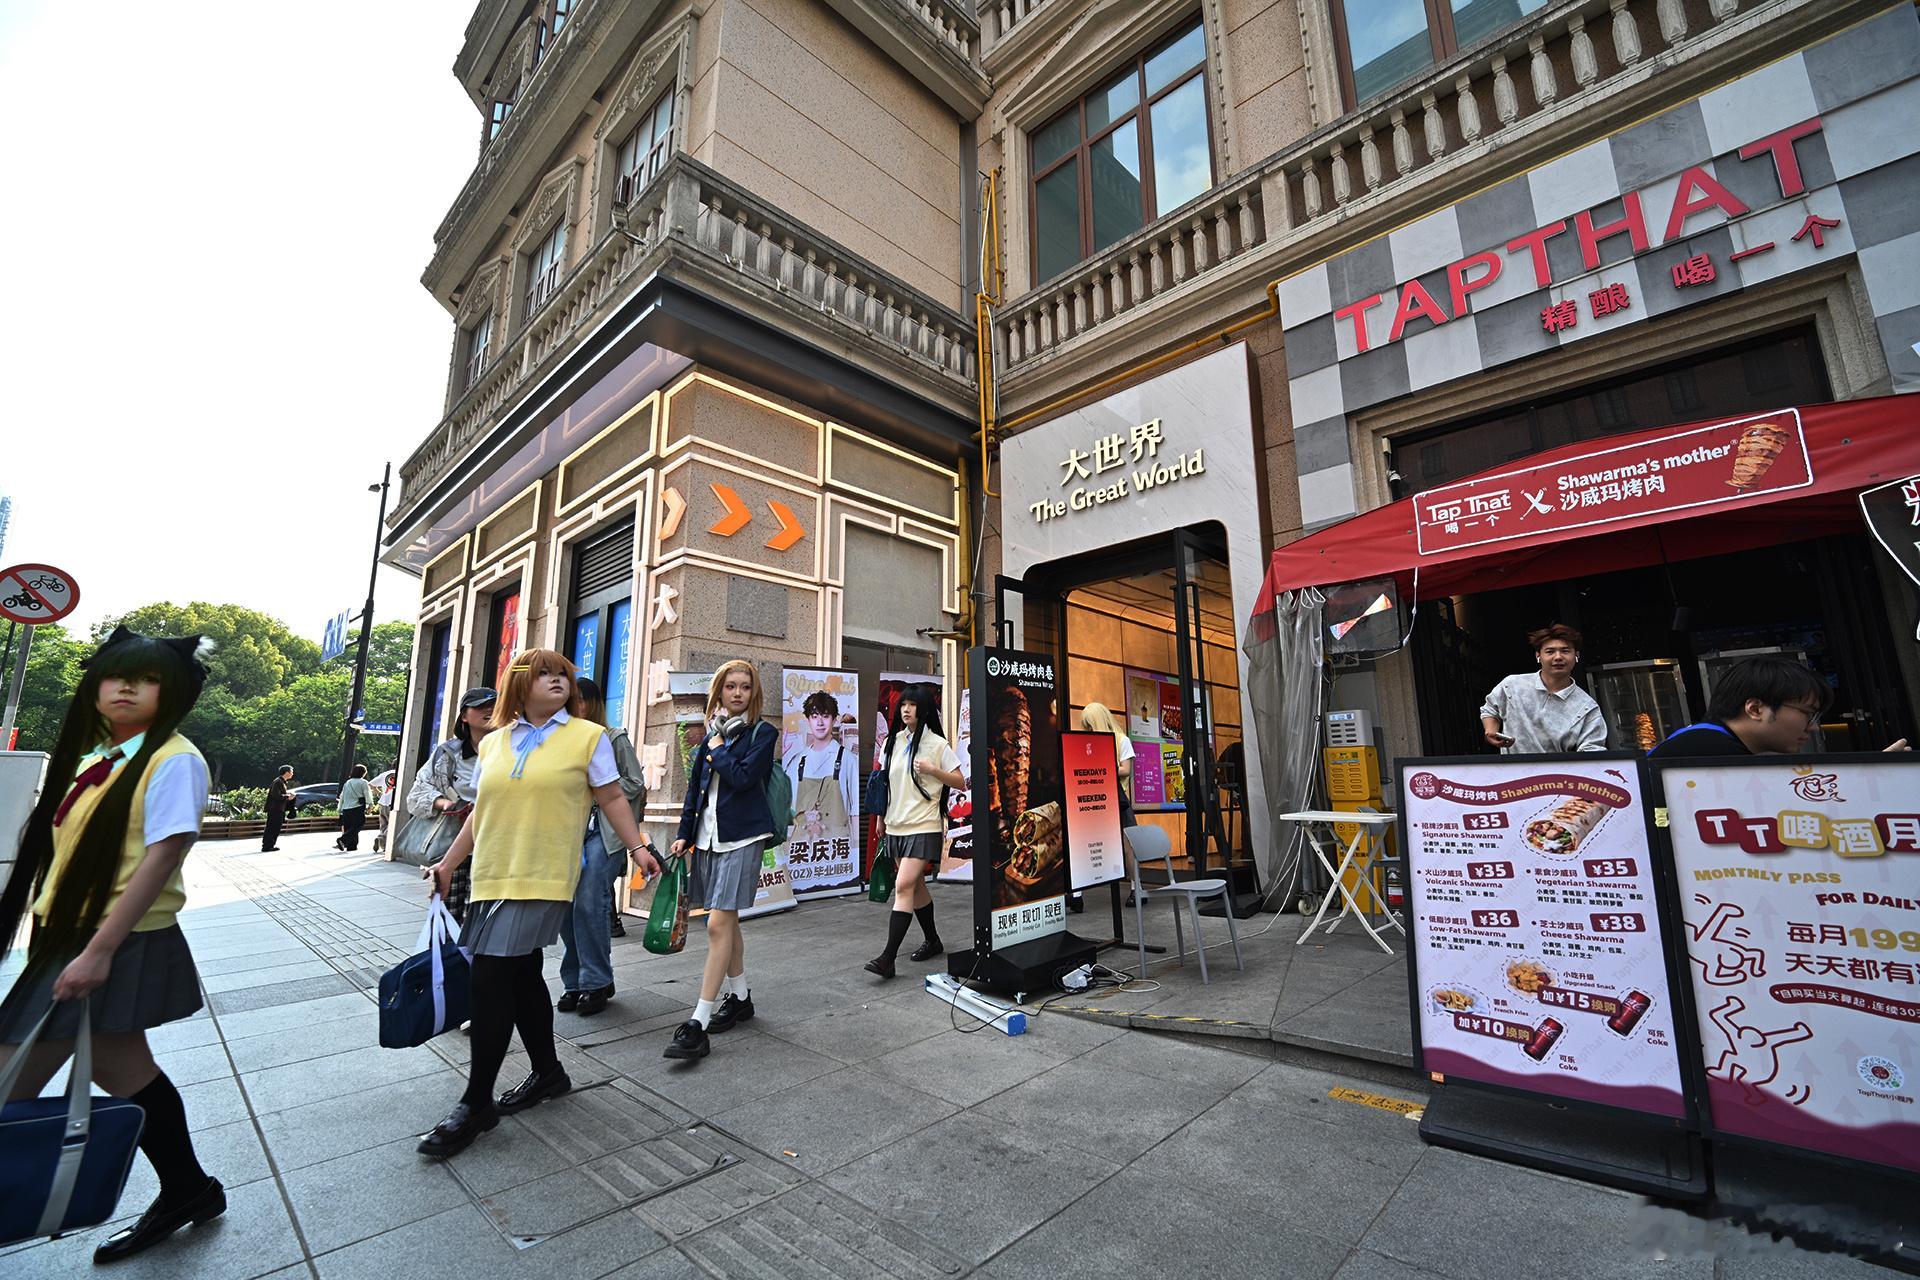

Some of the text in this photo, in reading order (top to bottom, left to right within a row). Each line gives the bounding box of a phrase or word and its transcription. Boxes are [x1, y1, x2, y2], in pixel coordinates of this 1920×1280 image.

[1540, 214, 1840, 335] 精酿 喝一个
[1059, 417, 1165, 487] 大世界
[1557, 458, 1661, 490] Shawarma's
[1029, 449, 1205, 523] The Great World
[1560, 474, 1666, 511] 沙威玛烤肉
[1426, 489, 1511, 522] Tap That
[1445, 514, 1500, 534] 喝一个
[1000, 660, 1054, 680] 沙威玛烤肉卷
[1074, 768, 1107, 776] WEEKDAYS
[1077, 794, 1107, 804] WEEKEND
[1442, 784, 1498, 800] 沙威玛烤肉
[1578, 782, 1624, 803] Mother
[1470, 814, 1501, 828] ¥35
[1422, 832, 1459, 840] Signature
[789, 838, 850, 864] 梁庆海
[1425, 869, 1463, 878] 火山沙威玛
[1475, 864, 1506, 878] ¥35
[1592, 861, 1629, 875] ¥35
[1694, 868, 1842, 884] MONTHLY PASS
[1460, 880, 1503, 888] Shawarma
[1536, 878, 1637, 890] Vegetarian Shawarma
[1816, 892, 1858, 906] FOR
[998, 913, 1018, 930] 现烤
[1022, 907, 1040, 923] 现切
[1480, 912, 1512, 926] ¥36
[1540, 920, 1584, 930] 芝士沙威玛
[1600, 916, 1637, 930] ¥38
[1429, 926, 1506, 938] Low-Fat Shawarma
[1541, 930, 1625, 944] Cheese Shawarma
[1787, 921, 1920, 952] 每月199
[1563, 972, 1594, 980] 小吃升级
[1564, 980, 1595, 988] Upgraded
[1647, 1029, 1665, 1038] 可乐
[1647, 1038, 1668, 1046] Coke
[1559, 1055, 1575, 1063] 可乐
[1559, 1063, 1578, 1071] Coke
